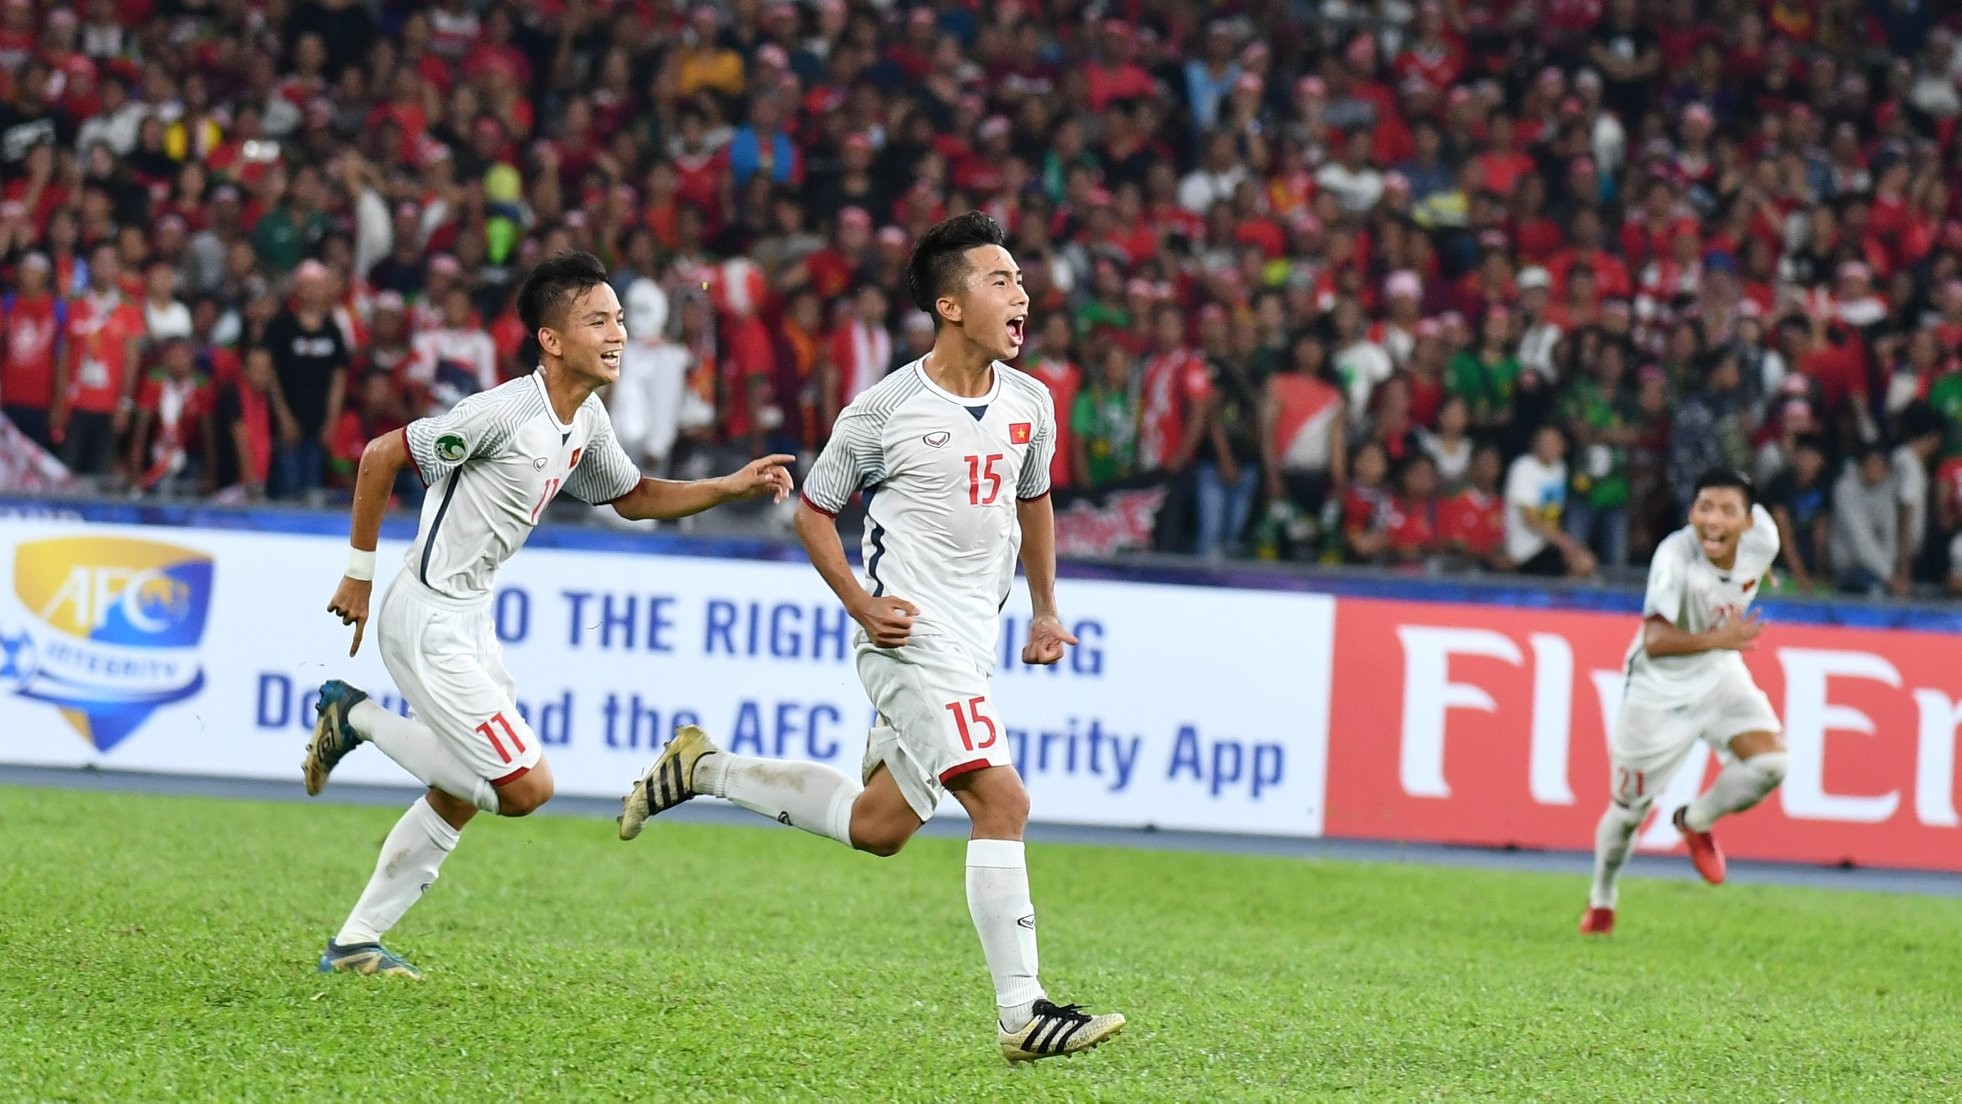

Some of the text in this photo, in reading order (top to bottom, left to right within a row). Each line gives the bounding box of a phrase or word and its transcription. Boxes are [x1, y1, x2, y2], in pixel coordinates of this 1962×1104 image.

[531, 478, 560, 523] 11
[963, 453, 1003, 506] 15
[40, 566, 172, 633] AFC
[563, 592, 676, 651] THE
[705, 599, 848, 661] RIGH
[475, 711, 526, 764] 11
[731, 702, 839, 759] AFC
[1167, 727, 1284, 798] App
[945, 696, 997, 751] 15
[1618, 766, 1646, 796] 21
